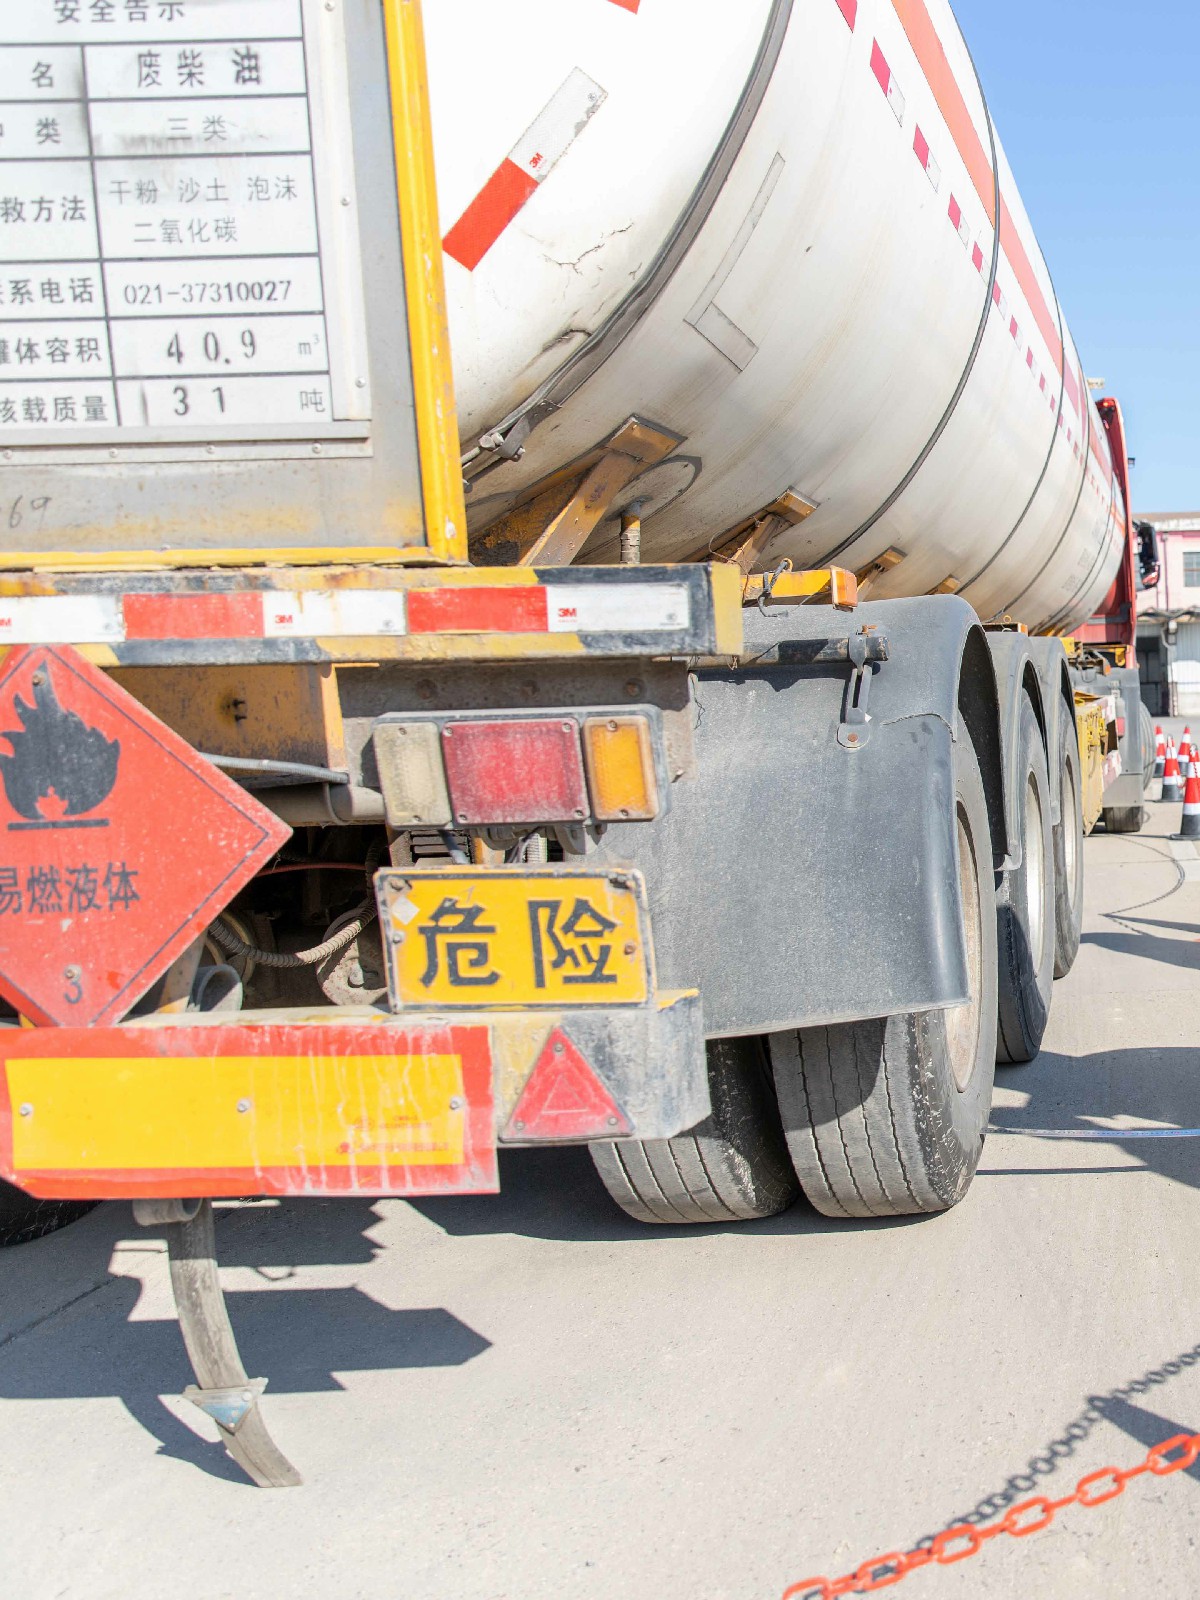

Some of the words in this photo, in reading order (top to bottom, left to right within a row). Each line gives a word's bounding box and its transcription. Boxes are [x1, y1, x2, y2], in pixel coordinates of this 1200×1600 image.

[54, 0, 186, 24] 安全告示
[31, 61, 55, 88] 名
[138, 47, 261, 87] 废柴油
[167, 115, 227, 141] 三类
[529, 152, 543, 168] 3M
[110, 180, 159, 204] 干粉
[178, 178, 229, 203] 沙土
[247, 175, 298, 200] 泡沫
[0, 195, 86, 223] 救方法
[133, 217, 239, 244] 二氧化碳
[0, 277, 95, 305] 系电话
[124, 280, 292, 305] 021-37310027
[167, 330, 257, 365] 40.9
[300, 391, 326, 413] 吨
[274, 614, 293, 625] 3M
[558, 608, 577, 618] 3M
[0, 862, 140, 914] 易燃液体
[418, 897, 618, 988] 危险
